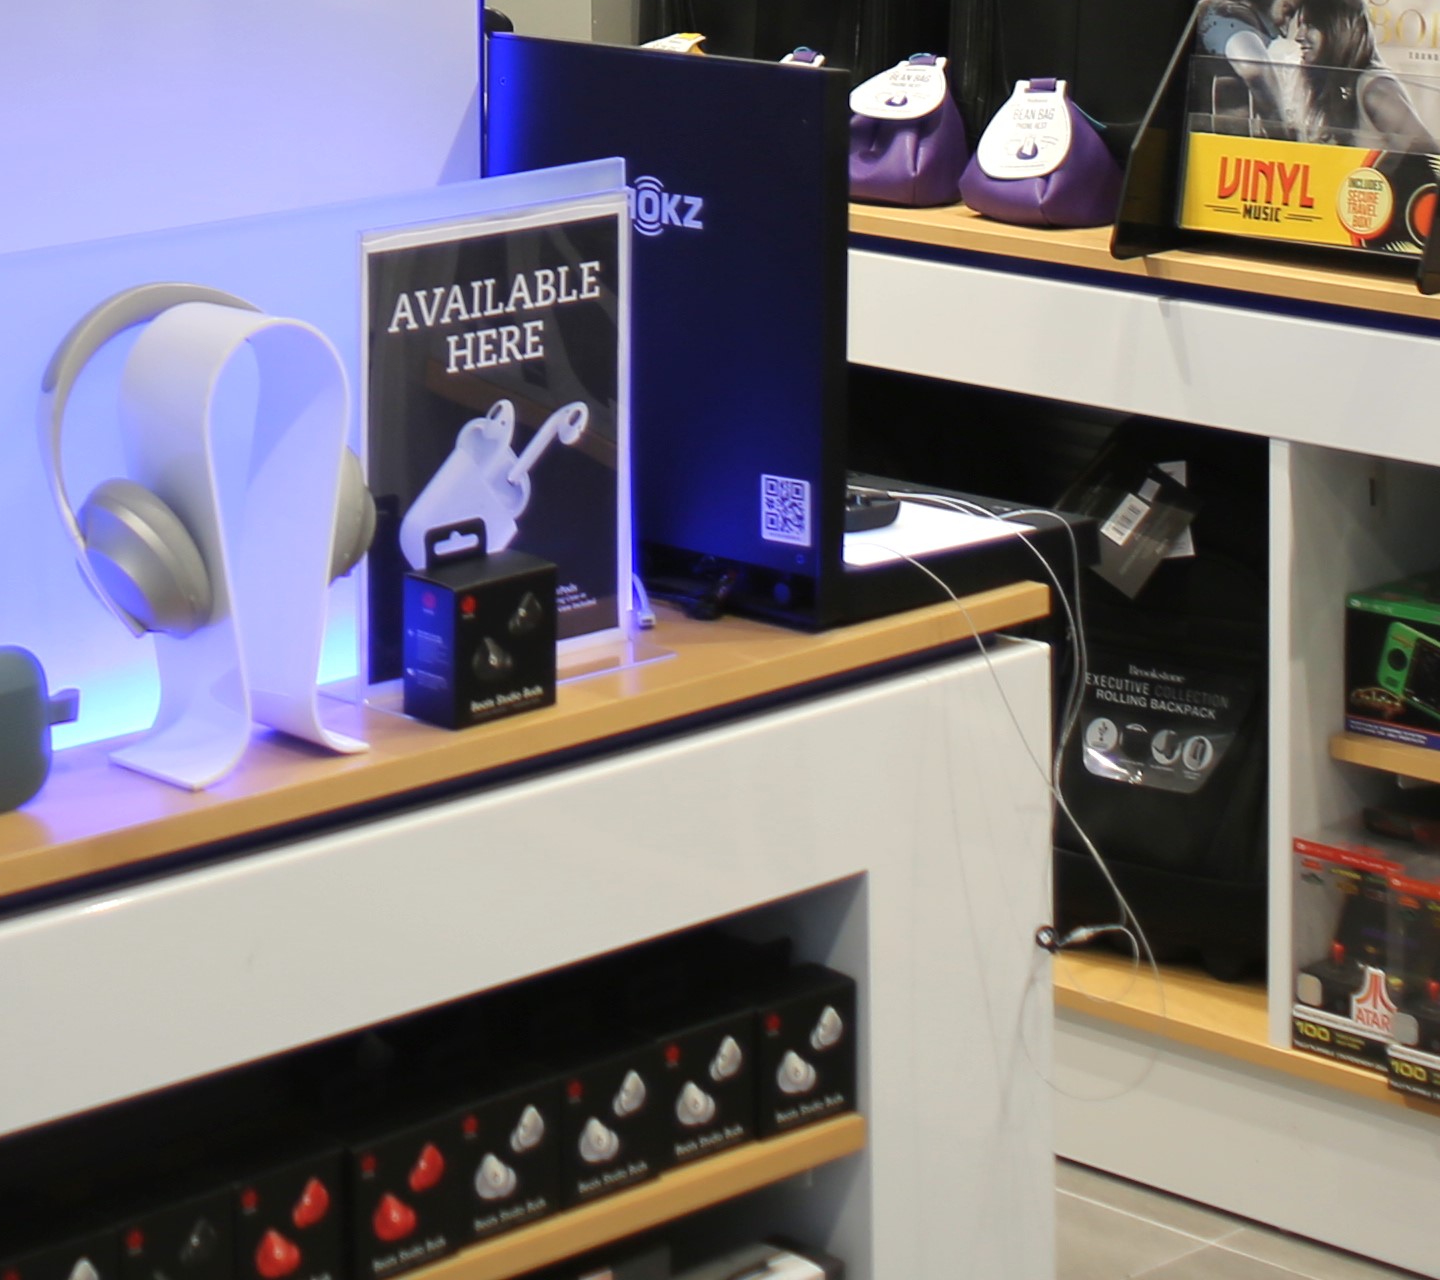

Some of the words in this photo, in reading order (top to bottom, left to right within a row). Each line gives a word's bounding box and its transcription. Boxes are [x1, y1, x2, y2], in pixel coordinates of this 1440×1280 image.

[1217, 156, 1314, 208] VINYL
[1243, 203, 1281, 222] MUSIC
[388, 261, 600, 333] AVAILABLE
[445, 320, 544, 373] HERE
[1086, 672, 1150, 695] EXECUTIVE
[1096, 688, 1147, 708] ROLLING
[1150, 698, 1216, 720] BACKPACK
